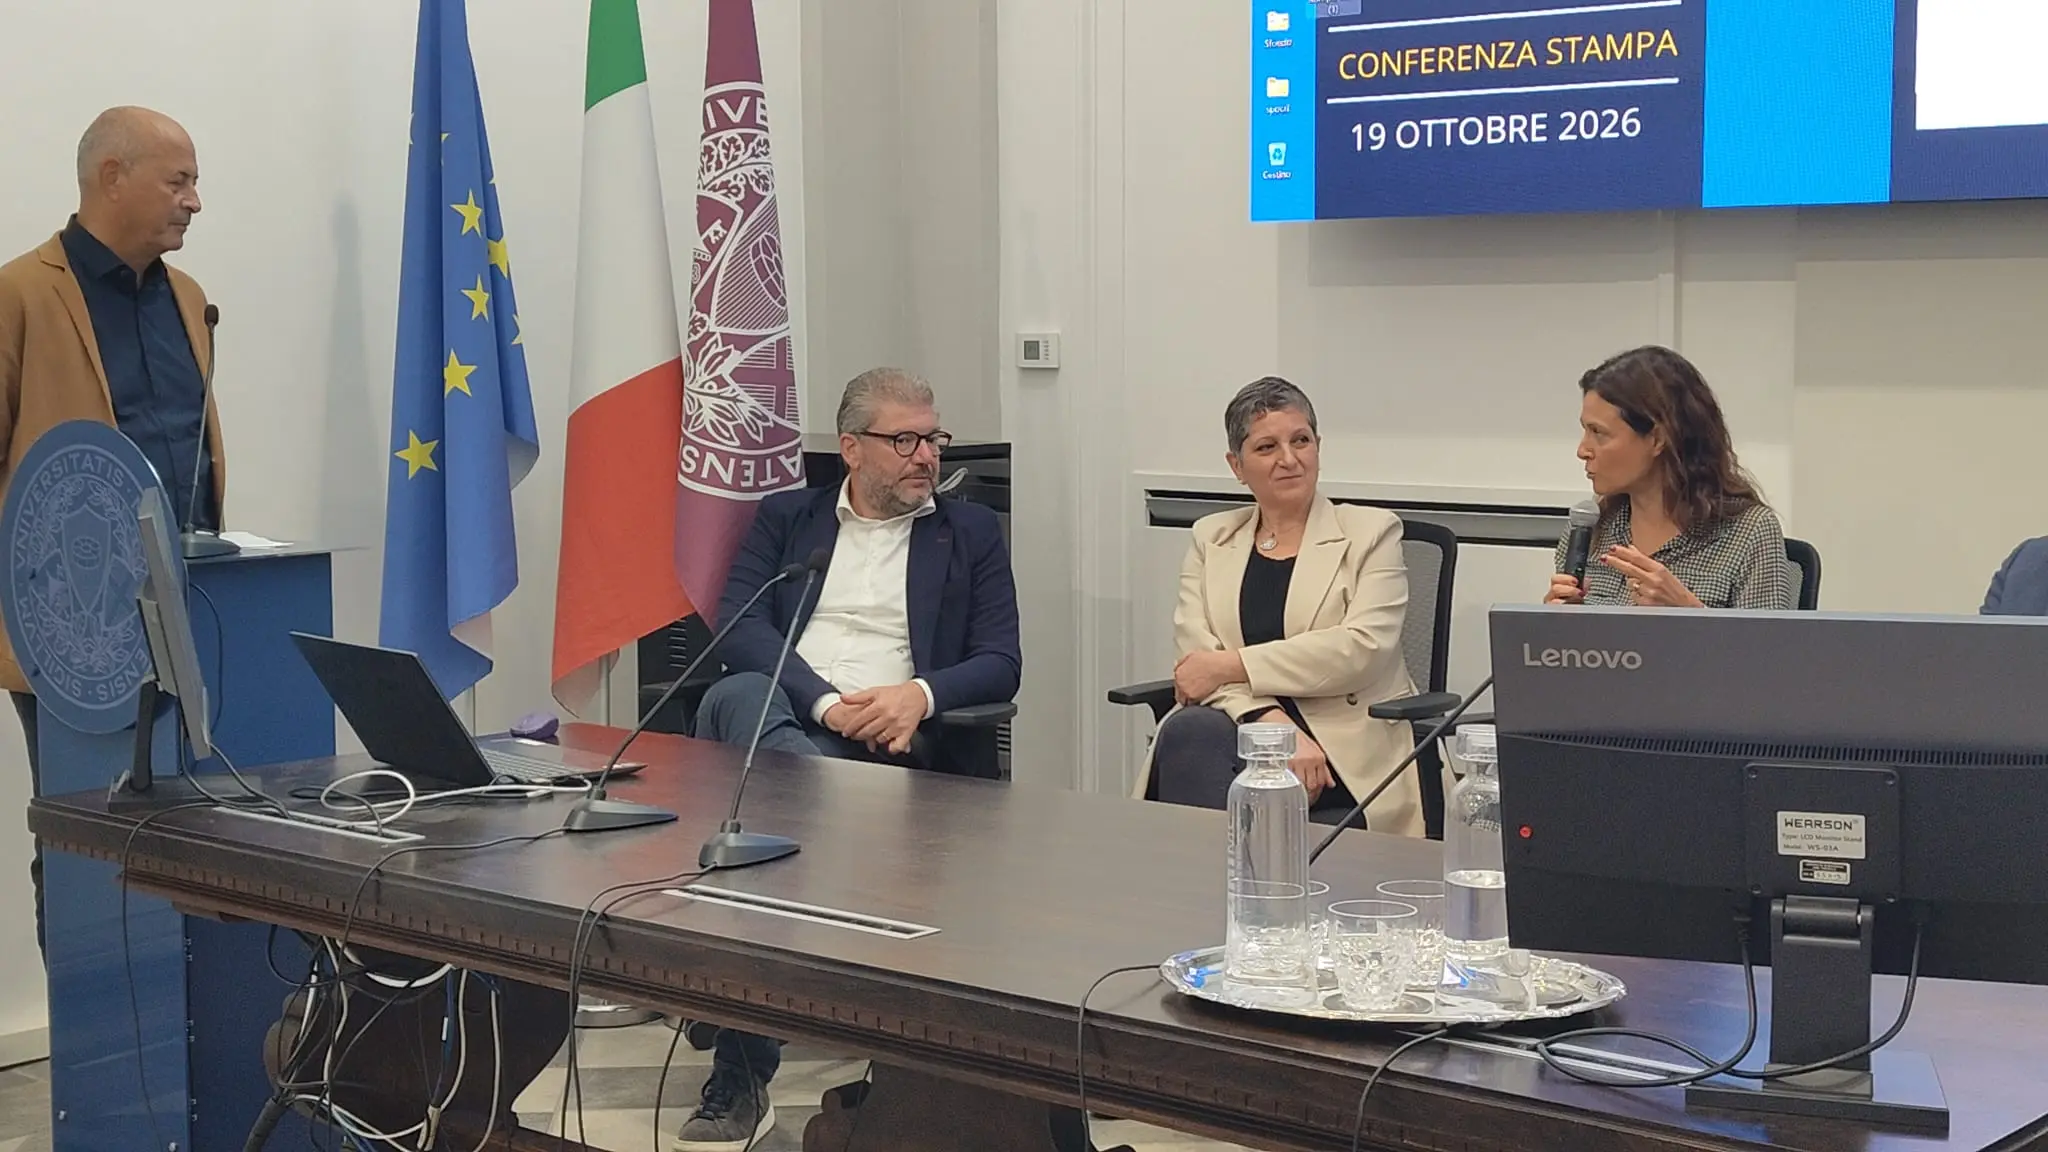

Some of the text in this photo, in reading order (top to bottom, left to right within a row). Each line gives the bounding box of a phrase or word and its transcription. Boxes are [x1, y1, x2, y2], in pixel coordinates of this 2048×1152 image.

[1339, 29, 1679, 80] CONFERENZA STAMPA
[1351, 107, 1641, 151] 19 OTTOBRE 2026
[1523, 642, 1643, 670] Lenovo
[1784, 818, 1854, 831] WEARSON
